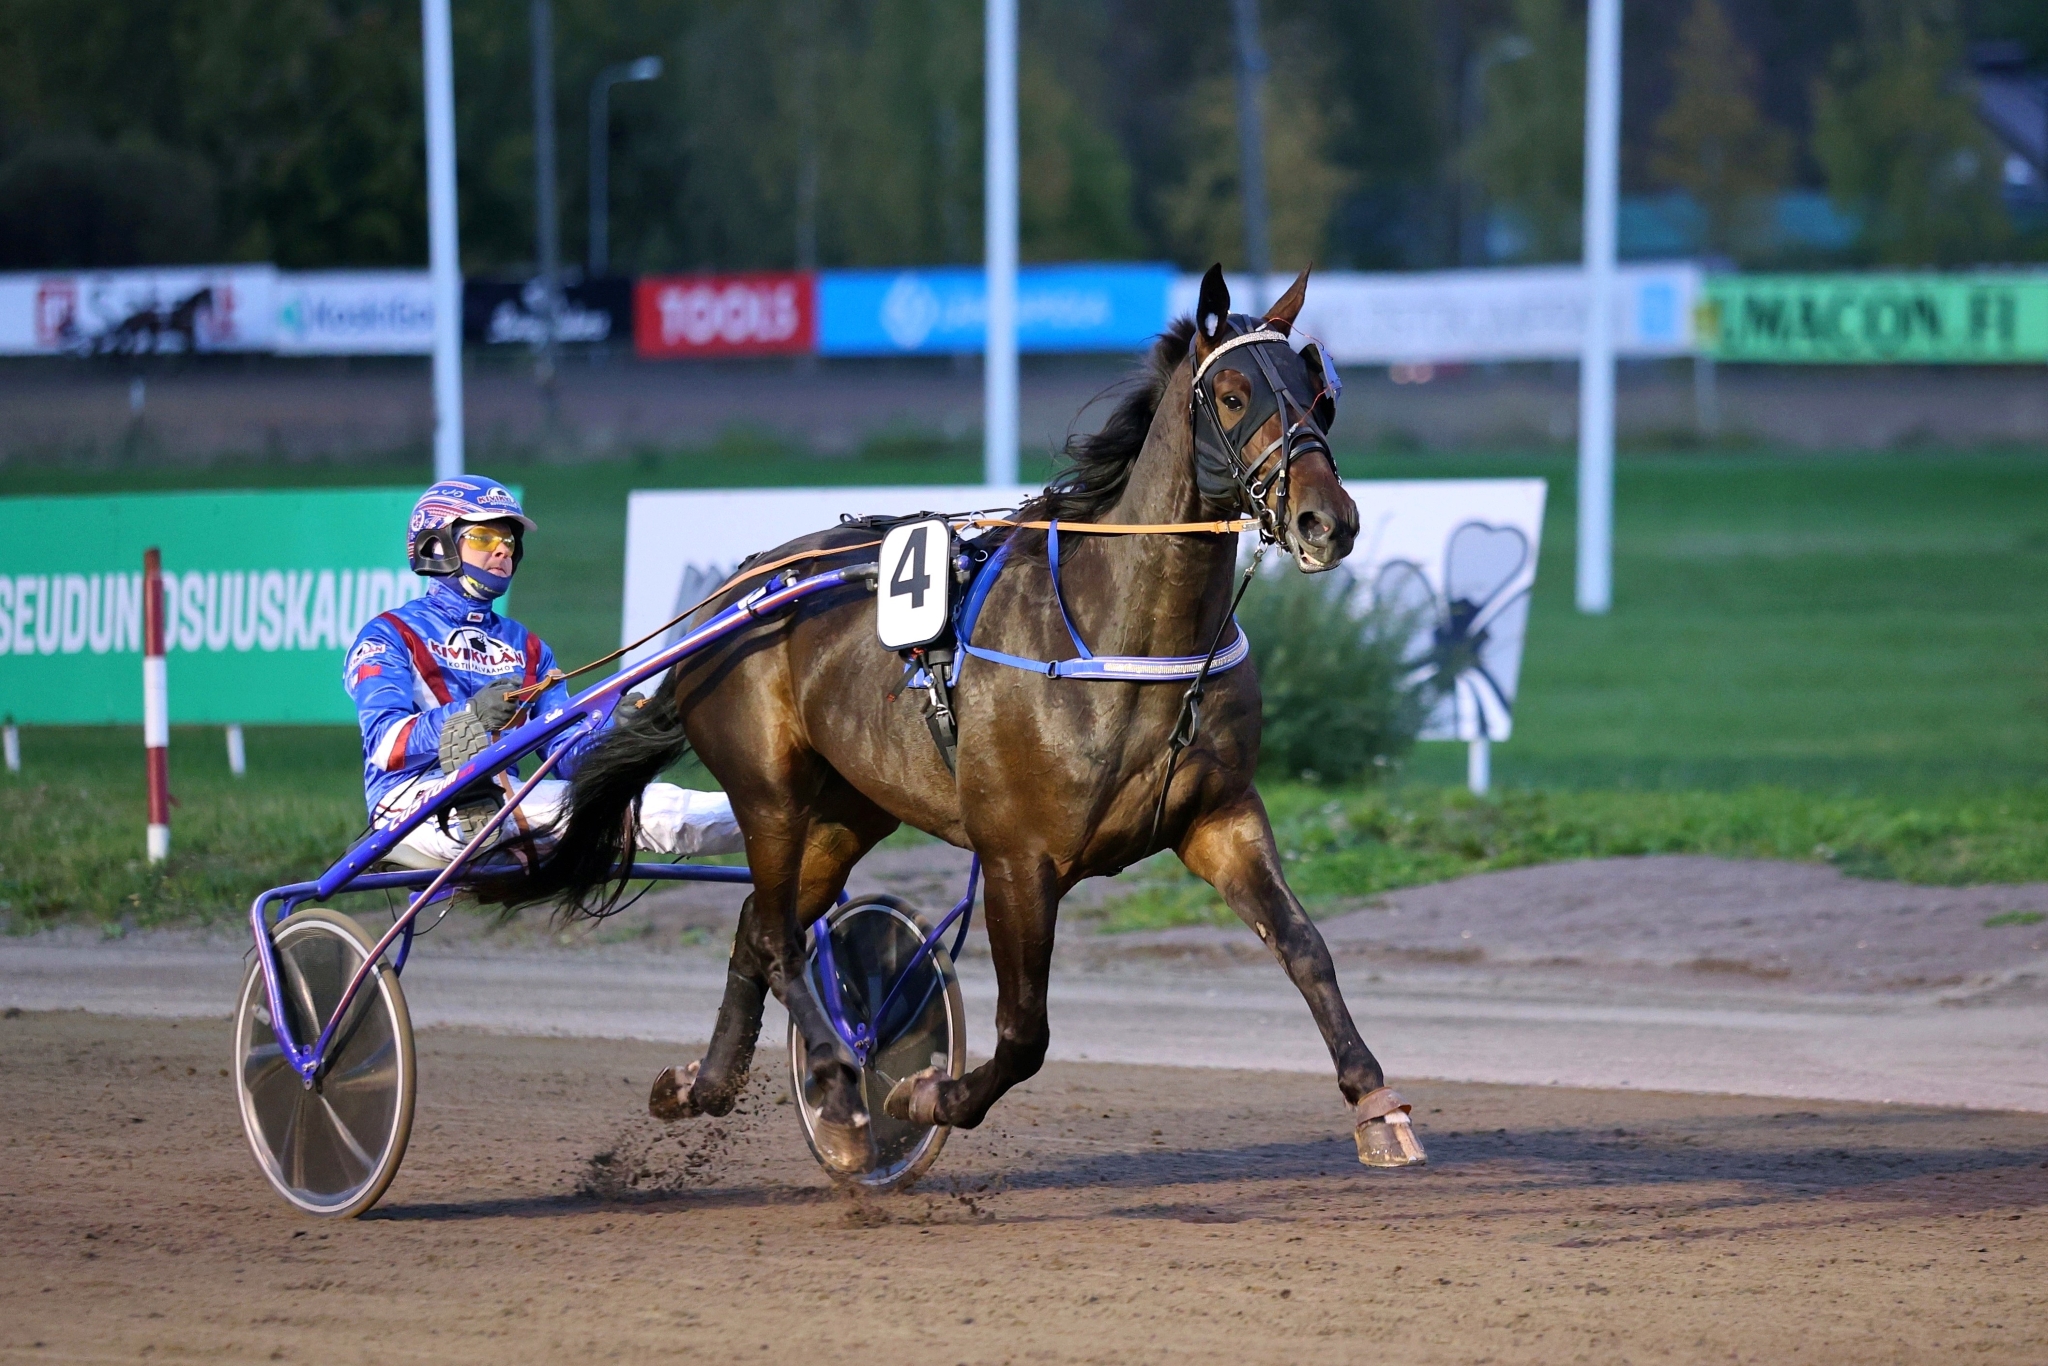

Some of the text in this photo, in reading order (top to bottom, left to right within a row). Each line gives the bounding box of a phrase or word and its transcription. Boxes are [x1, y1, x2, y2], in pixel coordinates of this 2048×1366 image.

[890, 526, 931, 609] 4
[431, 642, 524, 666] KIVIKYLÄN
[389, 769, 460, 831] CUSTOM
